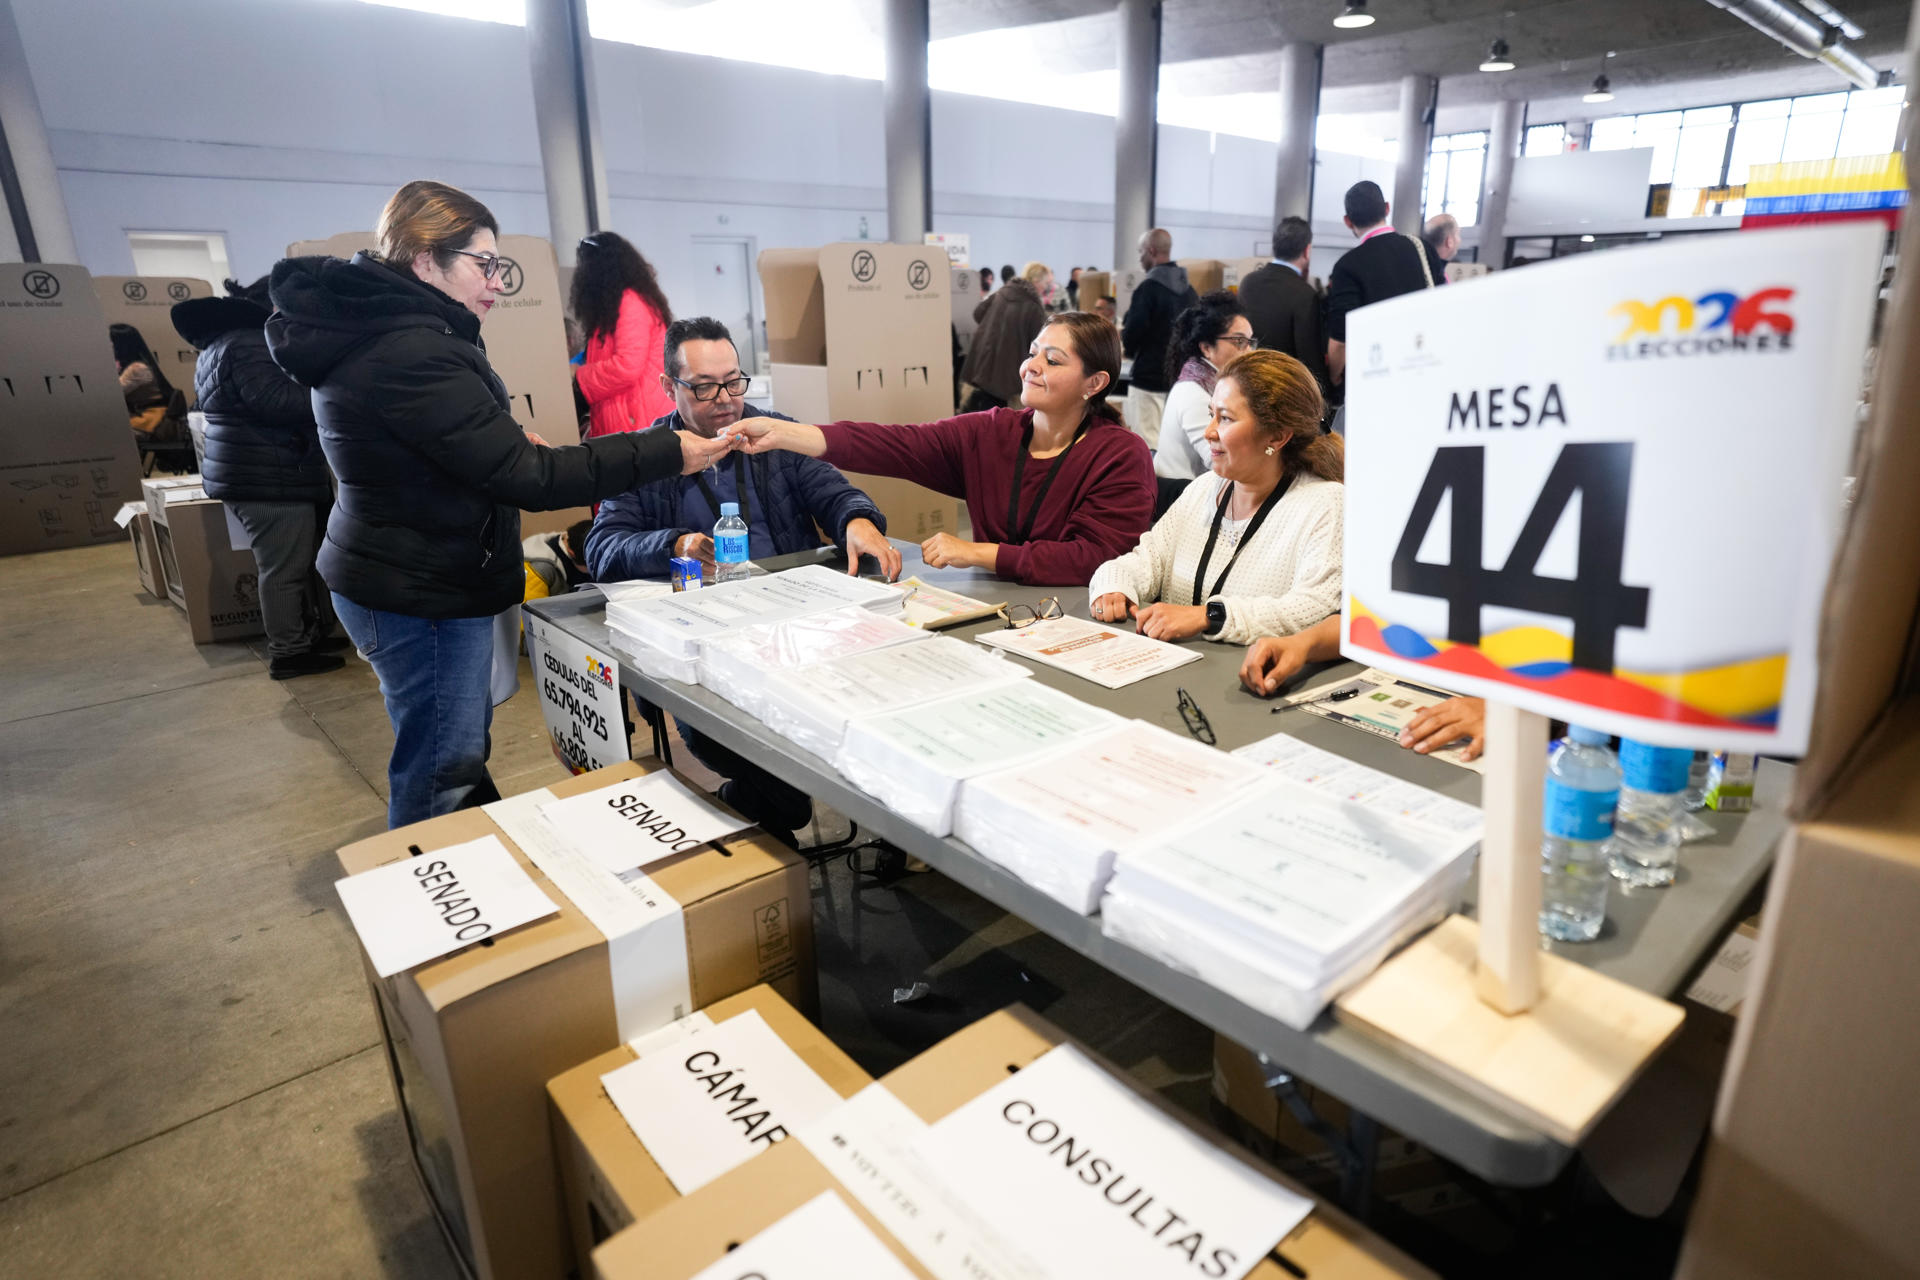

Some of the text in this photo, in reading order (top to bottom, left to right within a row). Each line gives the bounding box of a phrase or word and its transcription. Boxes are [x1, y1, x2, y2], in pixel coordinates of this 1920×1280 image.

[1606, 286, 1795, 345] 2026
[1605, 335, 1793, 363] ELECCIONES
[1447, 381, 1568, 432] MESA
[1390, 440, 1652, 677] 44
[544, 650, 599, 702] CÉDULAS DEL
[585, 655, 613, 687] 2026
[544, 677, 609, 742] 65.794.925
[572, 720, 586, 747] AL
[413, 860, 493, 941] SENADO
[685, 1051, 790, 1145] CÁMAR
[1002, 1100, 1238, 1278] CONSULTAS
